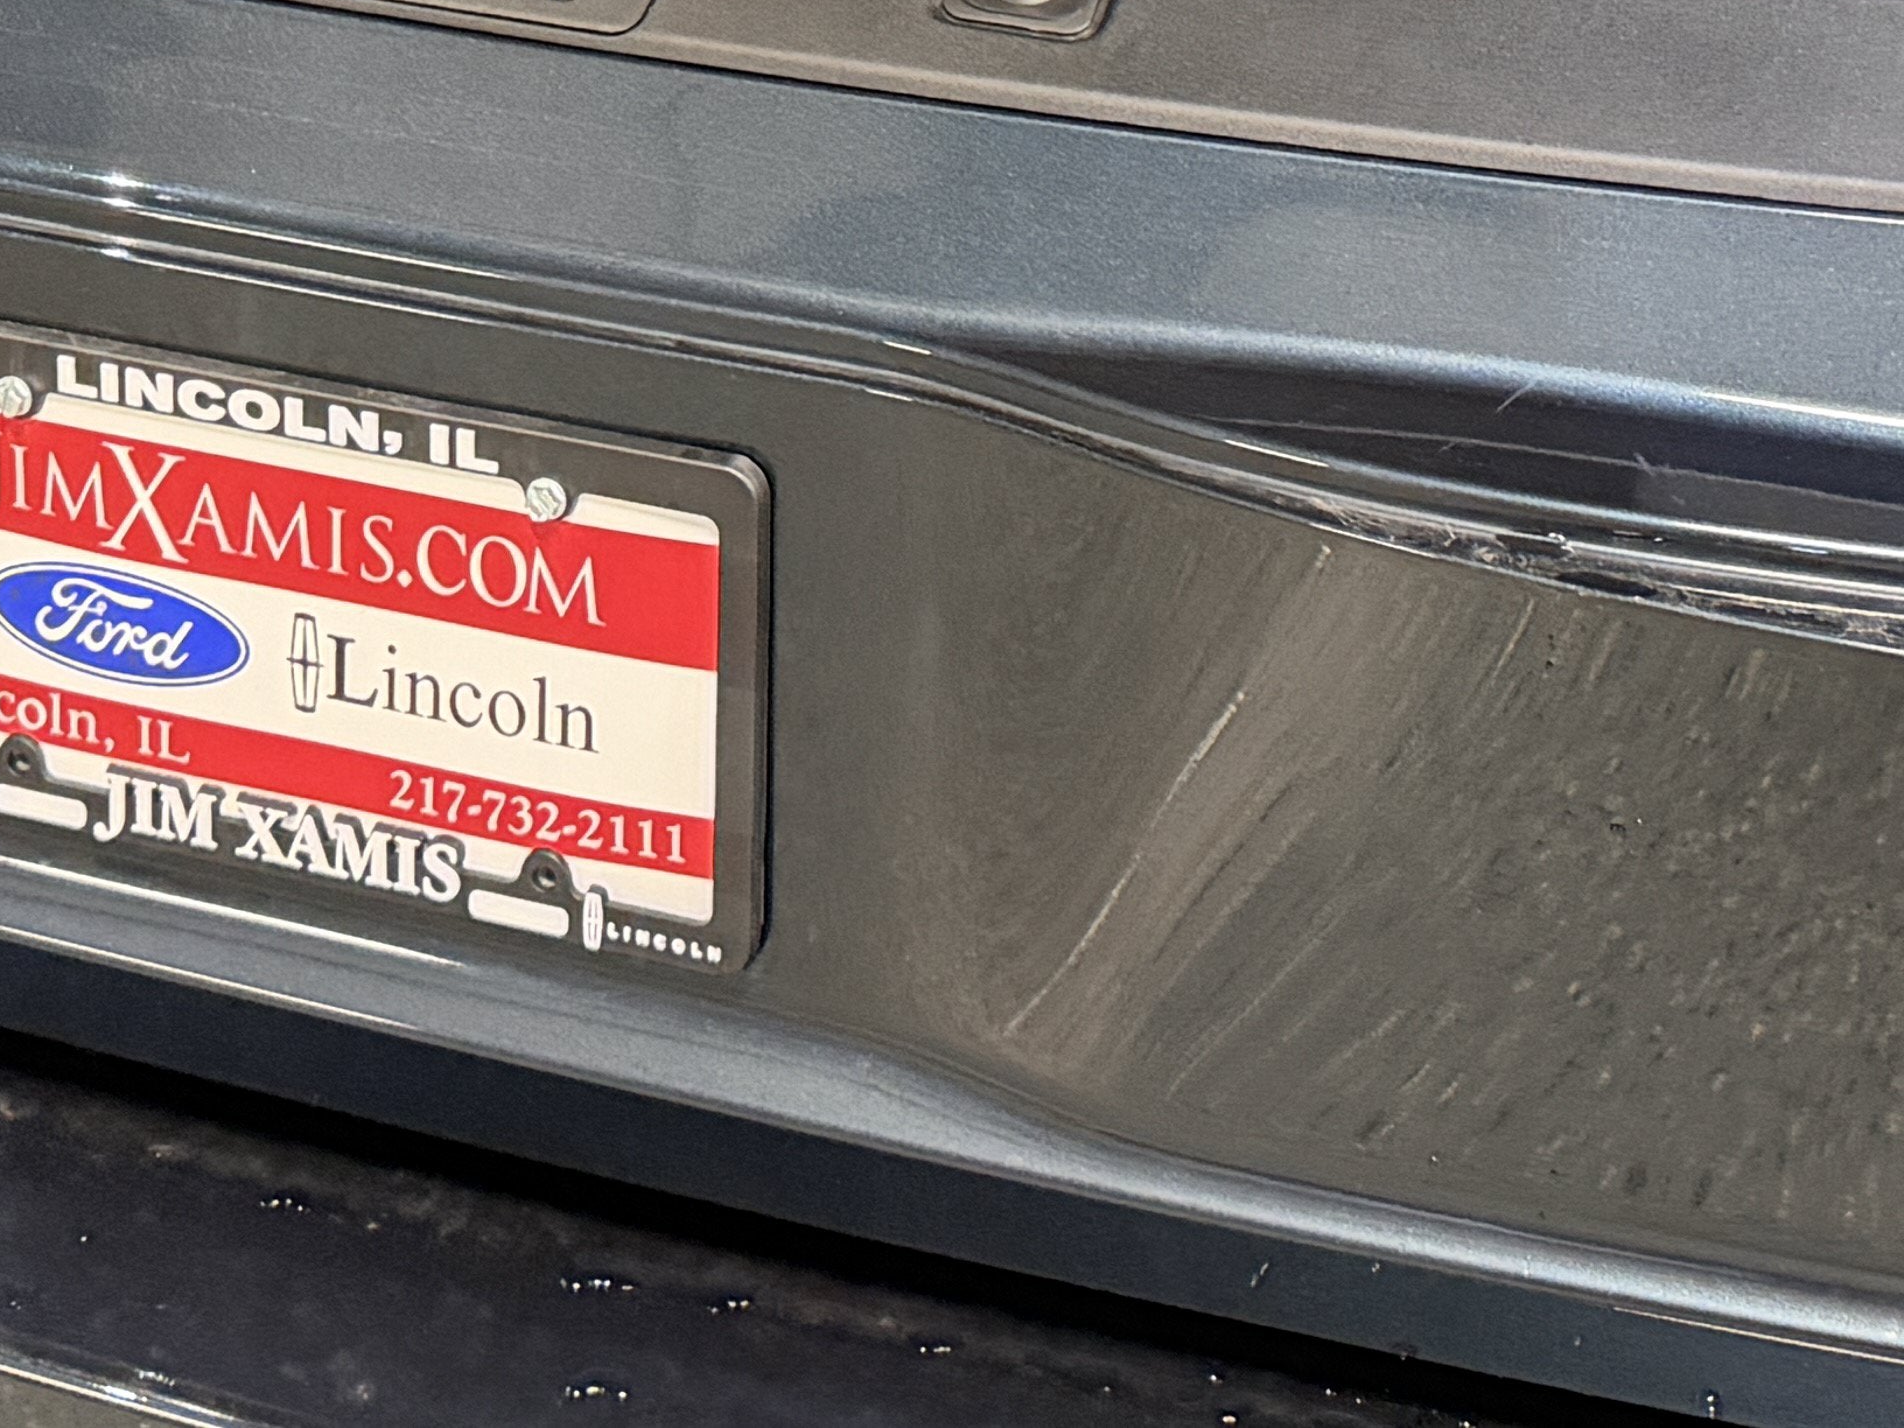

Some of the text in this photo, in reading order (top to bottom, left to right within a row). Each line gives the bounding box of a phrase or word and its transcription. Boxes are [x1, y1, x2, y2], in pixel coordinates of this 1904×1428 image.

[56, 353, 500, 475] LINCOLN, IL
[33, 576, 195, 671] Ford
[136, 715, 192, 765] IL
[325, 633, 600, 753] Lincoln
[93, 771, 461, 903] JIM XAMIS
[388, 768, 687, 865] 217-732-2111
[606, 921, 723, 964] LINCOLN
